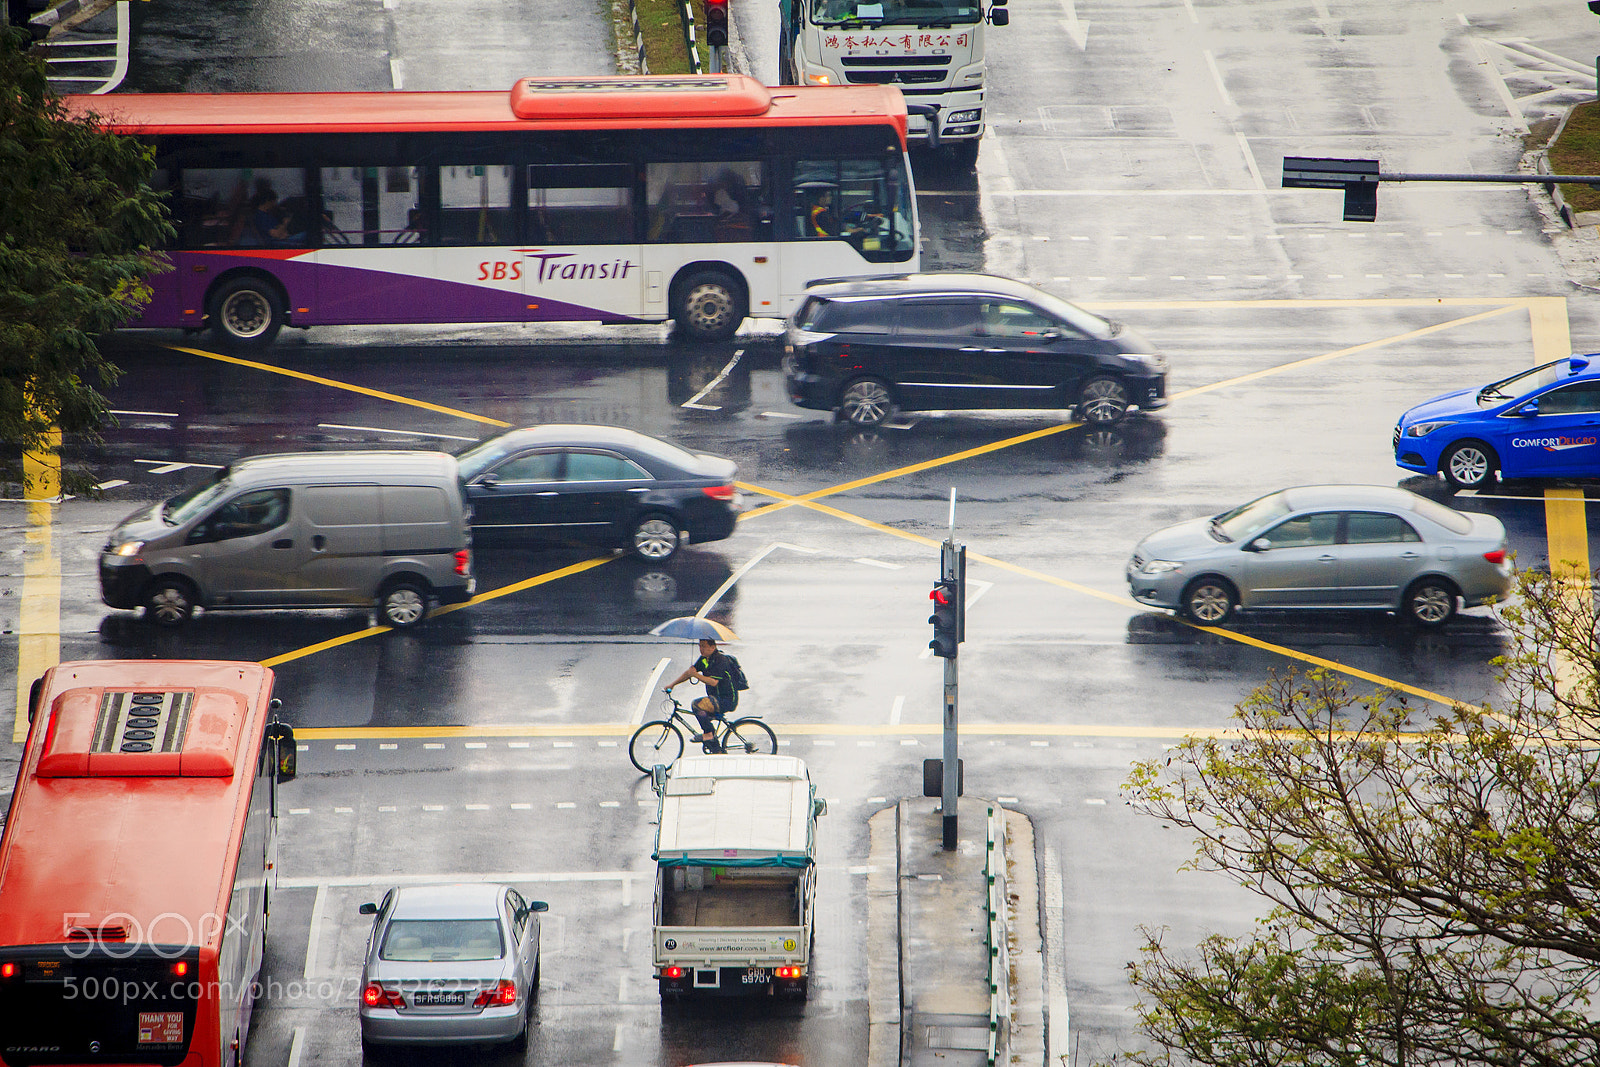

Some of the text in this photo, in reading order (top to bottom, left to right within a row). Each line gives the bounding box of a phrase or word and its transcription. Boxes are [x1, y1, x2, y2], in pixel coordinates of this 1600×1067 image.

[477, 253, 642, 284] SBS Transit
[141, 1014, 181, 1023] THANK YOU
